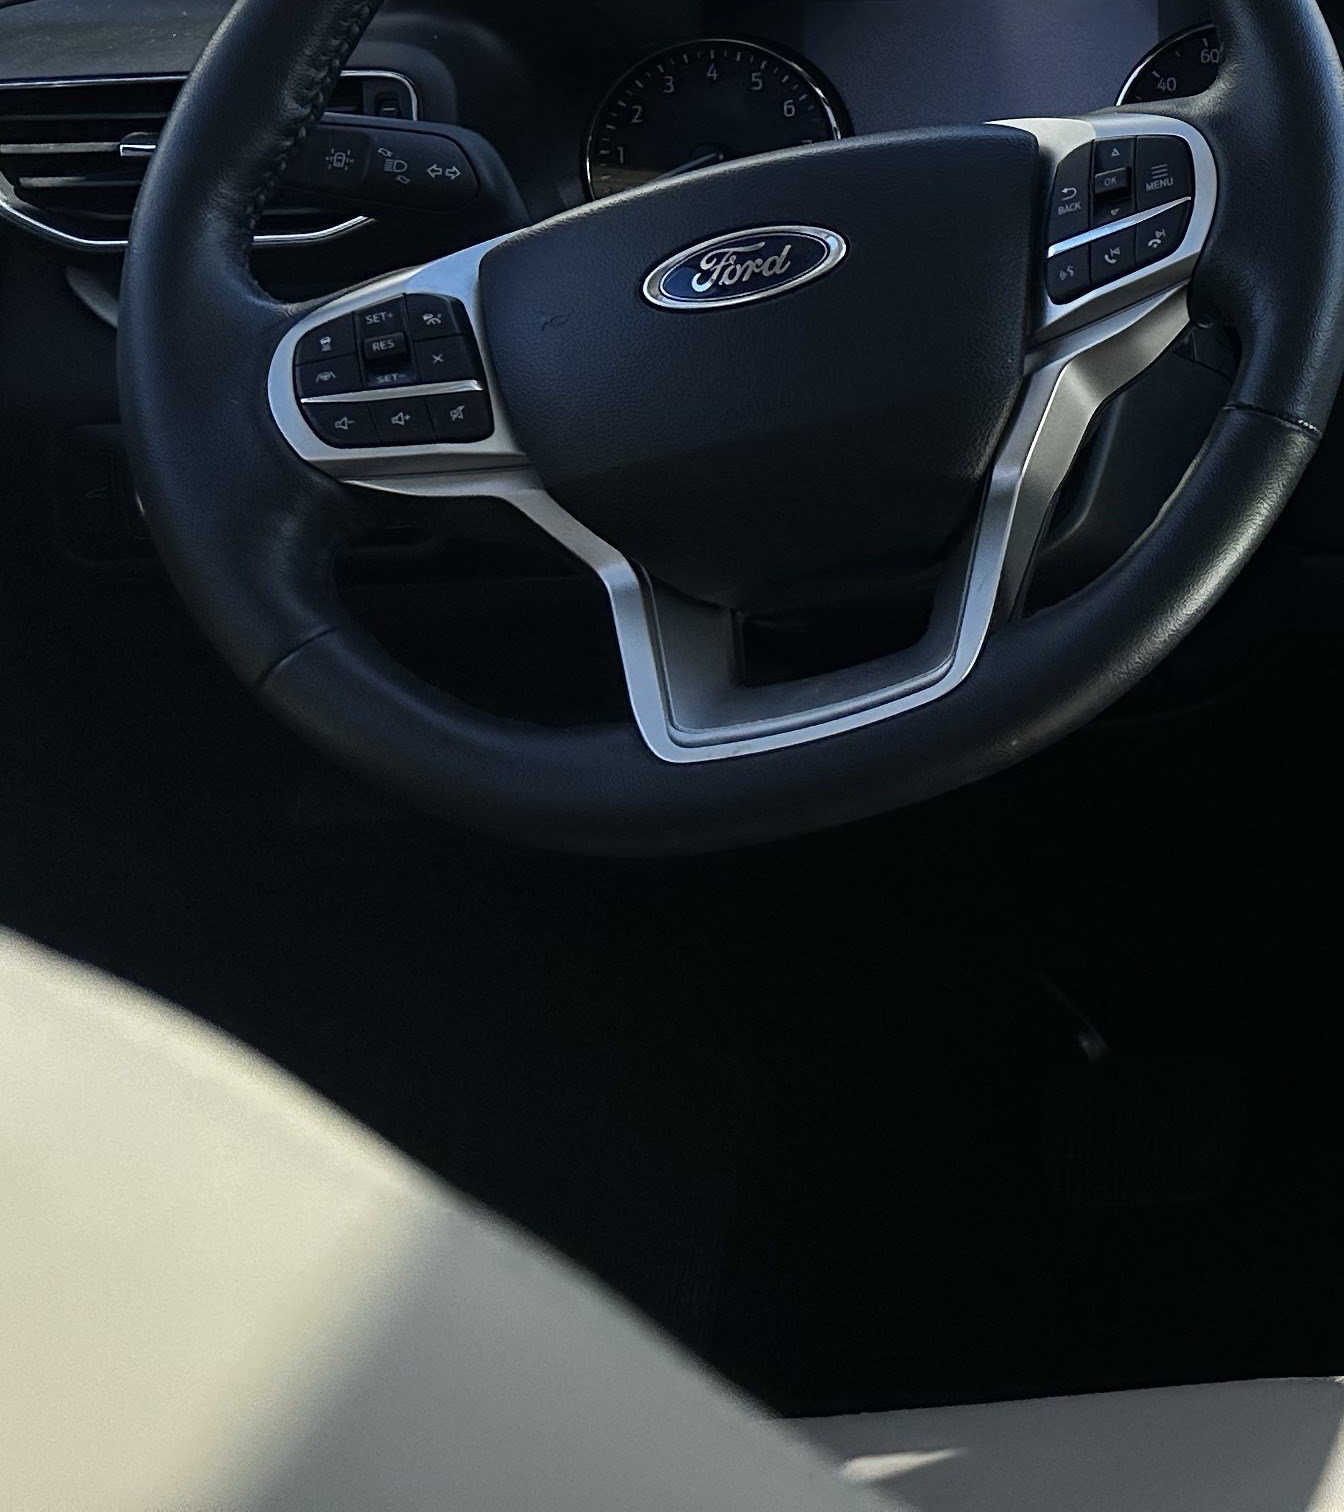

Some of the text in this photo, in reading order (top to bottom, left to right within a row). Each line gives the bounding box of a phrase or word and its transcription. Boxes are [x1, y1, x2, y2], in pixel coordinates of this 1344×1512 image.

[1200, 48, 1221, 64] 60
[706, 62, 719, 81] 4
[751, 71, 763, 91] 5
[663, 75, 675, 94] 3
[1157, 76, 1177, 93] 40
[631, 104, 643, 124] 2
[783, 99, 796, 118] 6
[616, 145, 625, 165] 1
[1103, 175, 1118, 187] OK
[1145, 177, 1174, 191] MENU
[1057, 201, 1082, 216] BACK
[690, 240, 791, 293] Ford
[372, 339, 395, 352] RES
